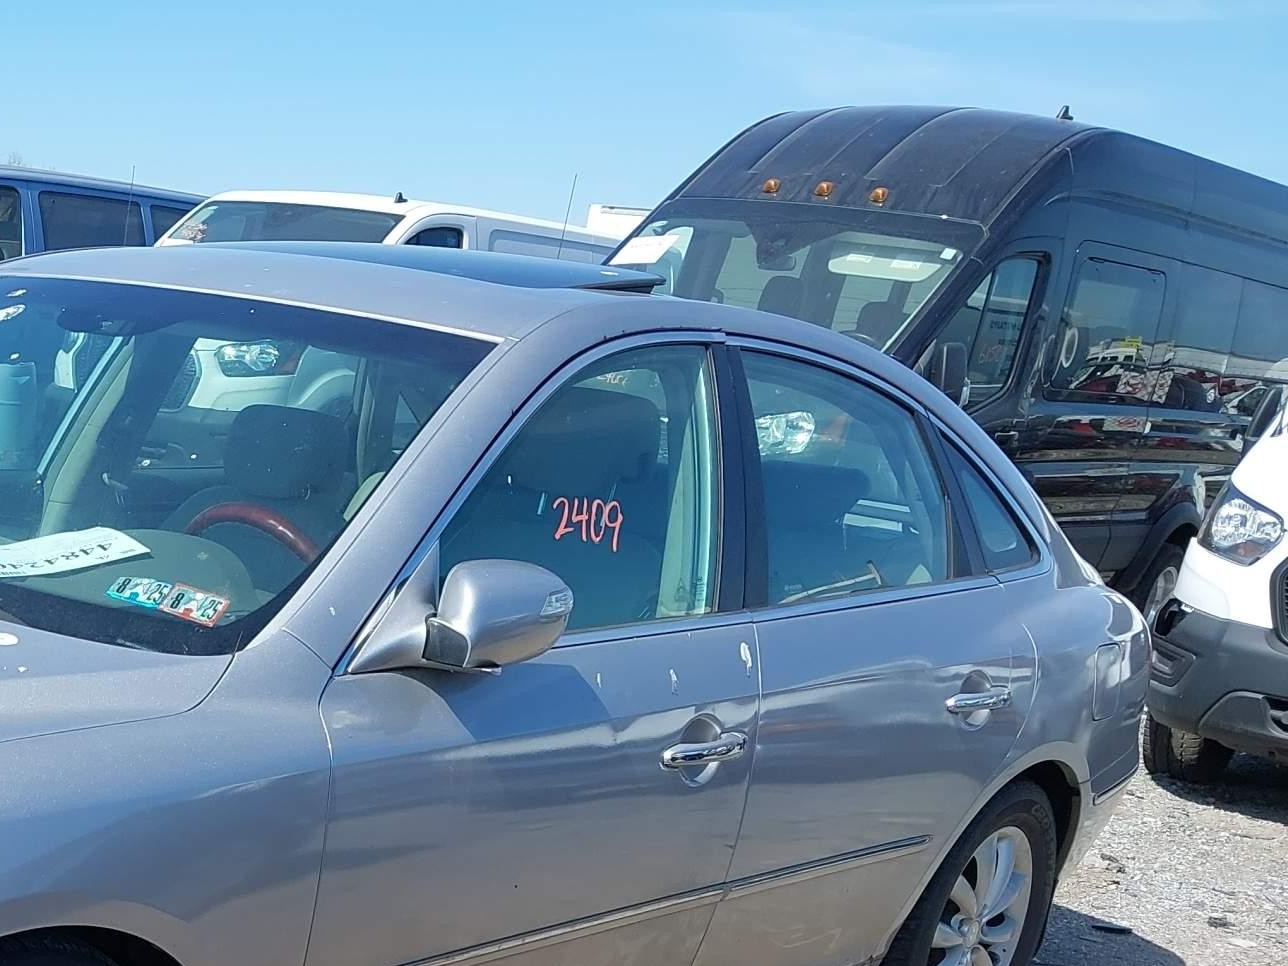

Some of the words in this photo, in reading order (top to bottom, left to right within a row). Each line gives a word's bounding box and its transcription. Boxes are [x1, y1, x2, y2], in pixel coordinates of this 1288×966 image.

[553, 497, 624, 553] 2409
[116, 578, 132, 594] 8
[146, 583, 169, 606] 25
[169, 592, 186, 609] 8
[200, 599, 223, 620] 25
